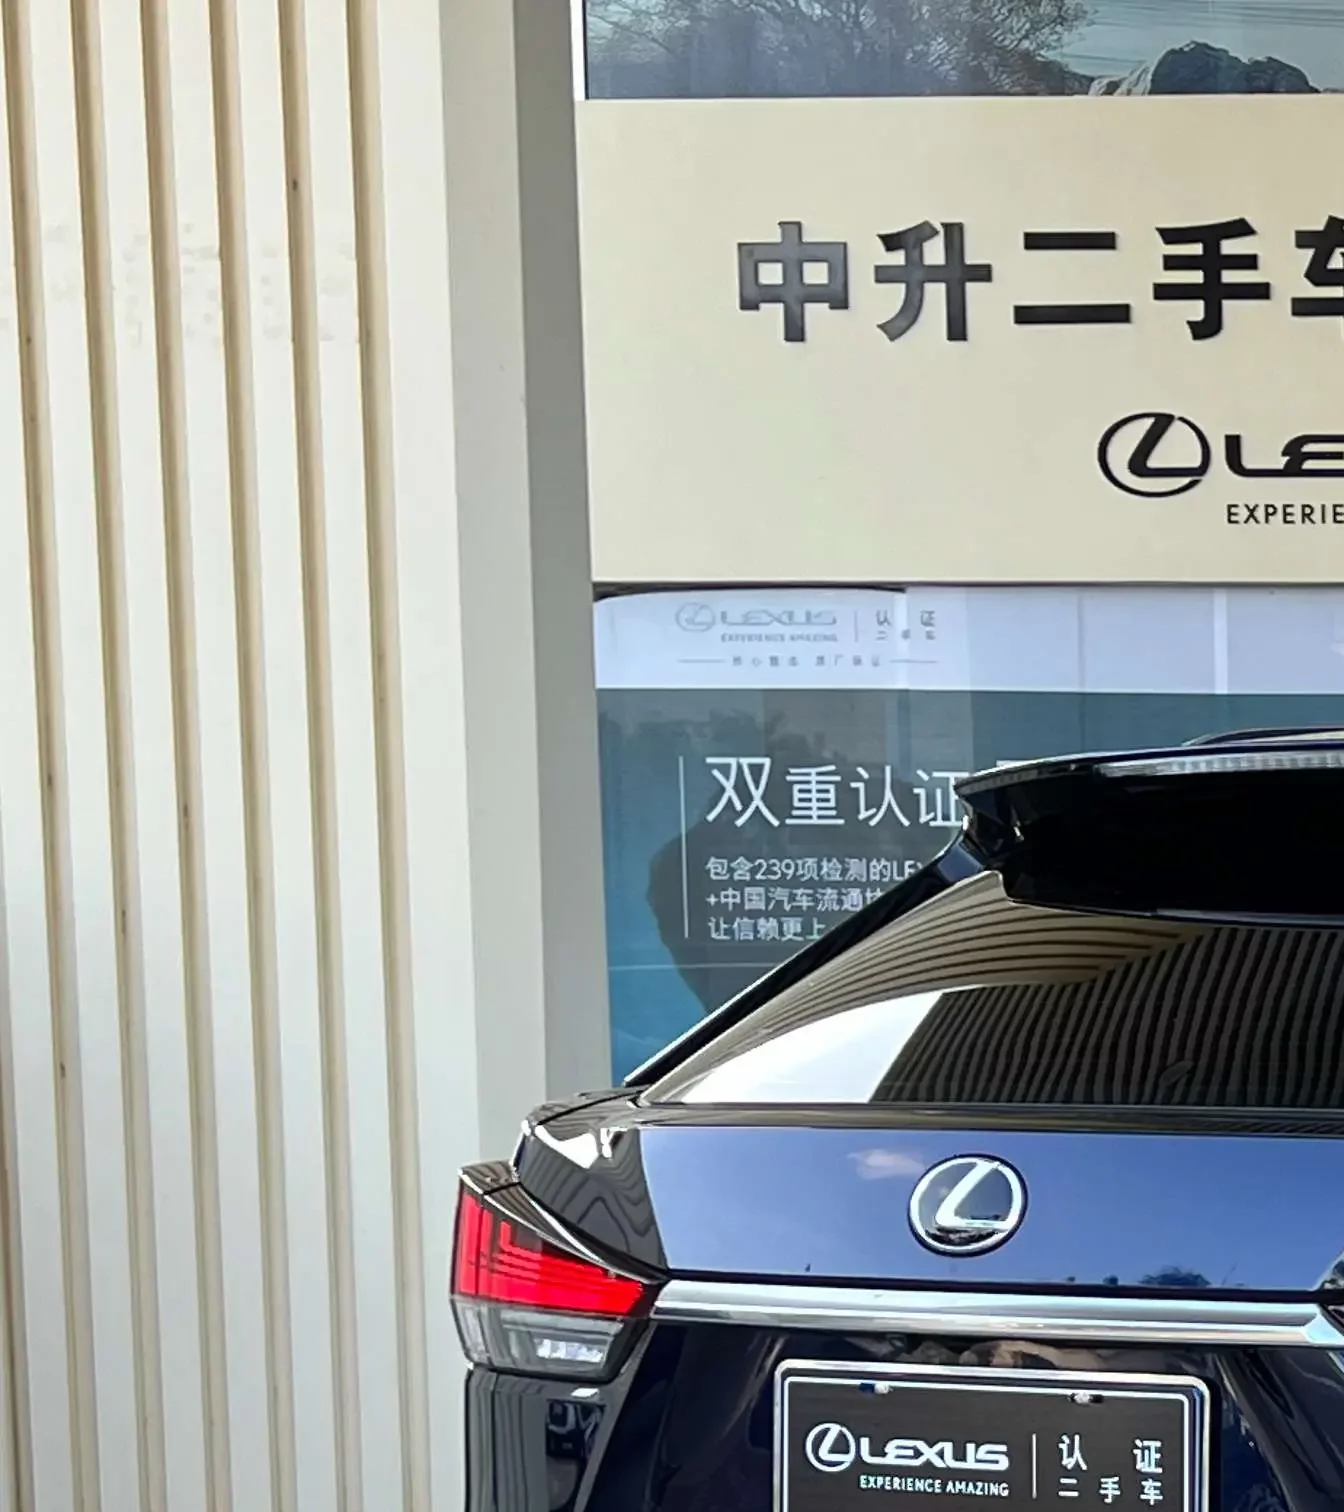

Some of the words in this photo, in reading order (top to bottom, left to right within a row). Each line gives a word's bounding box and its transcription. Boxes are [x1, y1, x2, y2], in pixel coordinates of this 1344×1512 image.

[720, 609, 837, 626] LEXUS
[705, 756, 971, 828] 双重认证
[859, 1435, 1010, 1472] LEXUS
[859, 1474, 942, 1494] EXPERIENCE
[946, 1478, 1010, 1498] AMAZING
[1058, 1475, 1164, 1506] 二手车
